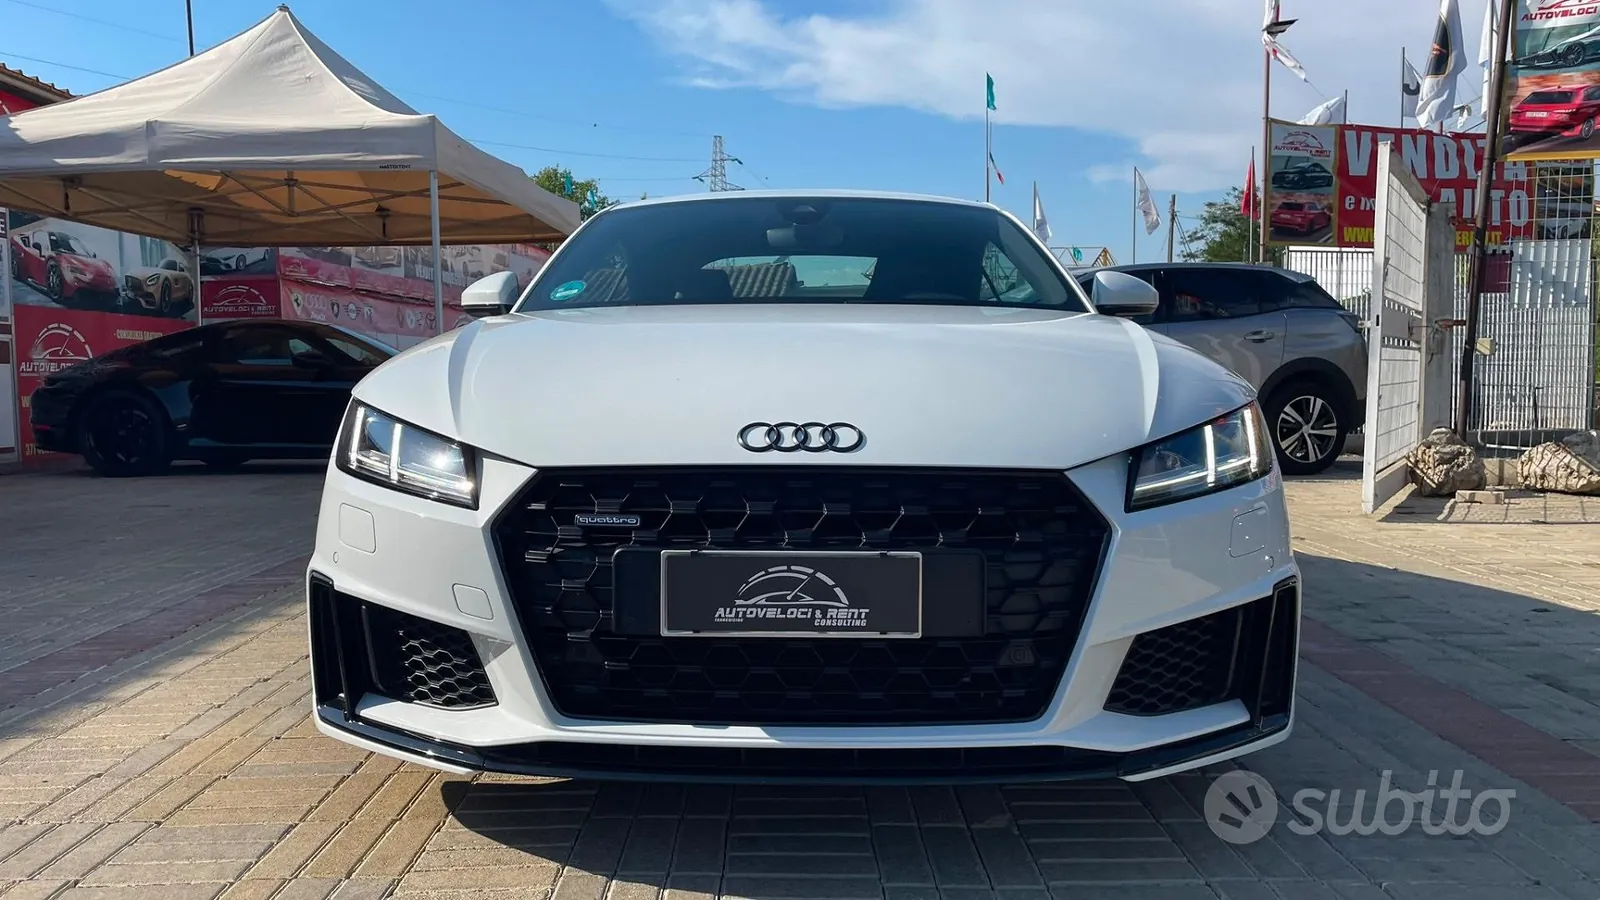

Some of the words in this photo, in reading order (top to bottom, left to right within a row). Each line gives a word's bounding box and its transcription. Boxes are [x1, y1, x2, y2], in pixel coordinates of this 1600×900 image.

[1521, 6, 1598, 20] AUTOVELOCI
[1344, 130, 1527, 182] VNDIA
[579, 516, 637, 524] quattro
[714, 607, 812, 619] AUTOVELOCI
[814, 609, 822, 619] &
[826, 608, 870, 619] RENT
[814, 618, 867, 627] CONSULTING
